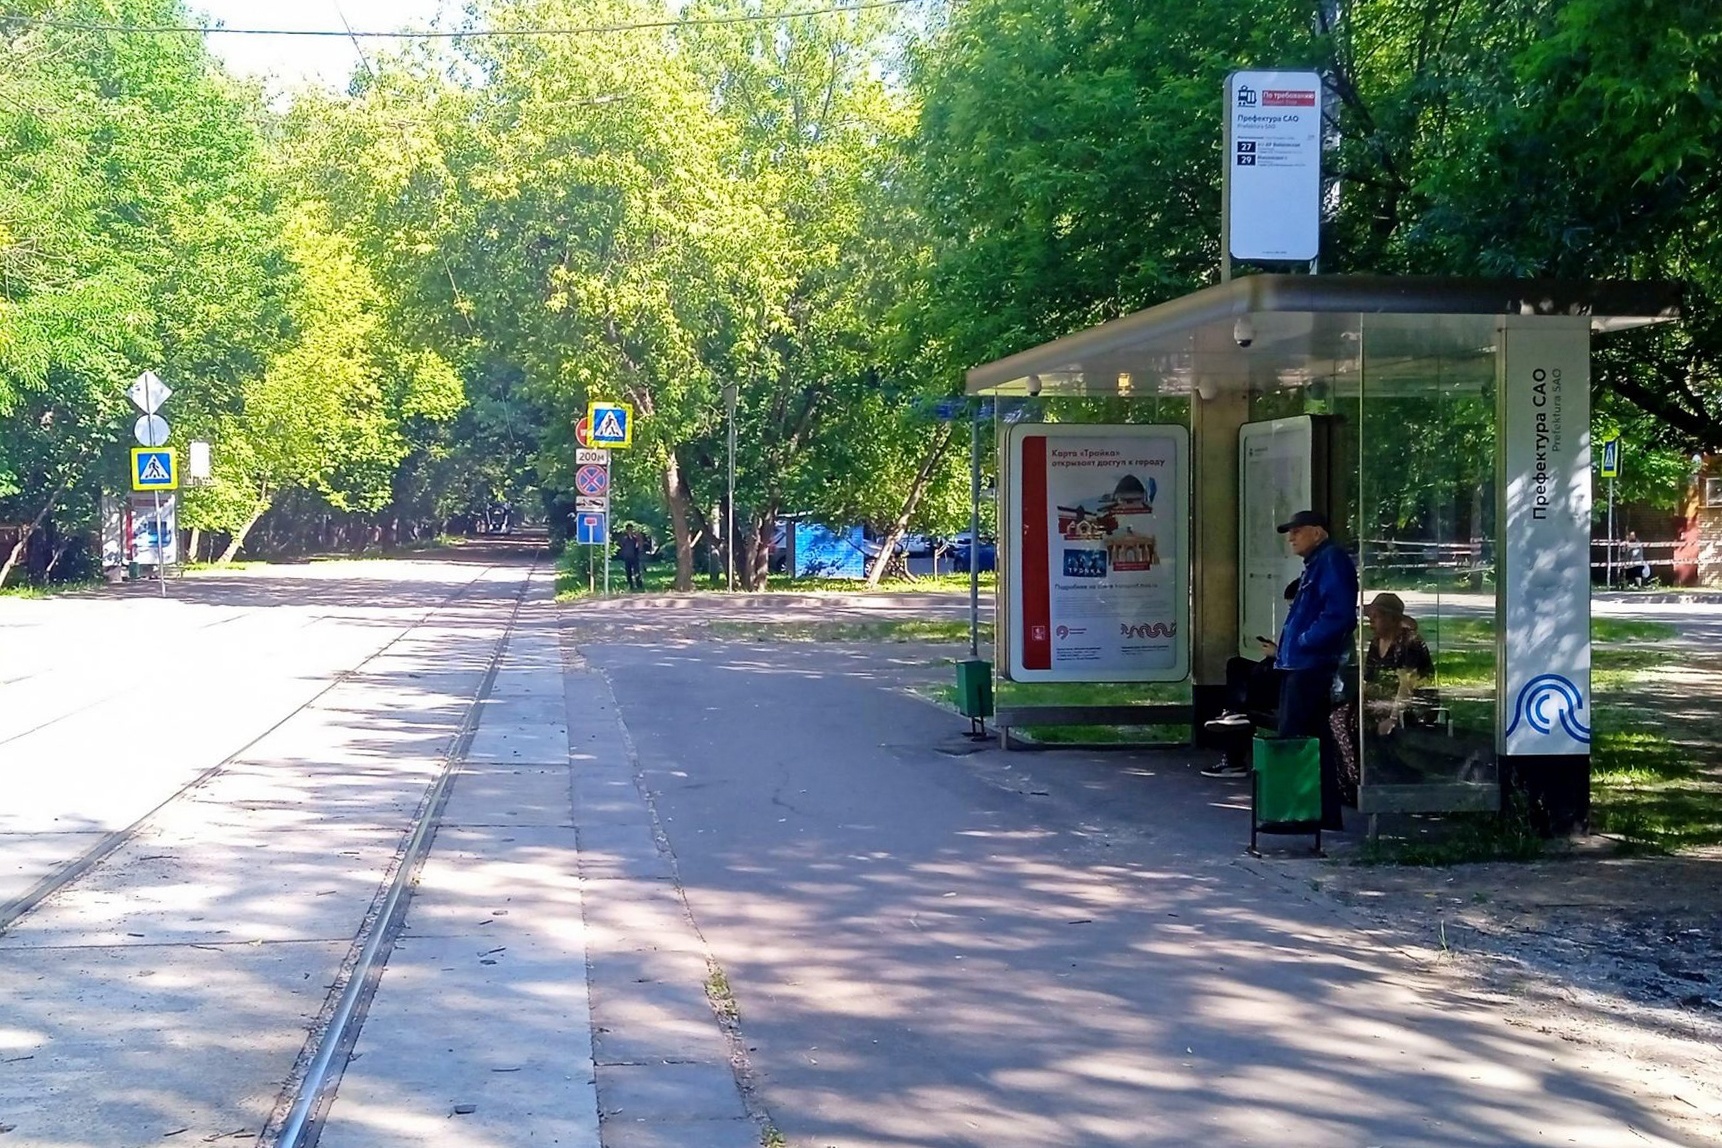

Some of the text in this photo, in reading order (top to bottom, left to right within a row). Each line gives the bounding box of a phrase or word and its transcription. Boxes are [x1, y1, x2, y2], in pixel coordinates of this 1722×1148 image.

[1263, 91, 1273, 99] По
[1237, 114, 1282, 123] Префектура
[1241, 143, 1252, 151] 27
[1241, 156, 1252, 164] 29
[1551, 368, 1562, 452] Prefektura SAO
[1532, 368, 1550, 520] Префектура САО
[1051, 448, 1120, 458] Карта «Тройка»
[1051, 460, 1096, 468] открывает
[1097, 460, 1127, 468] доступ
[1135, 458, 1166, 468] городу
